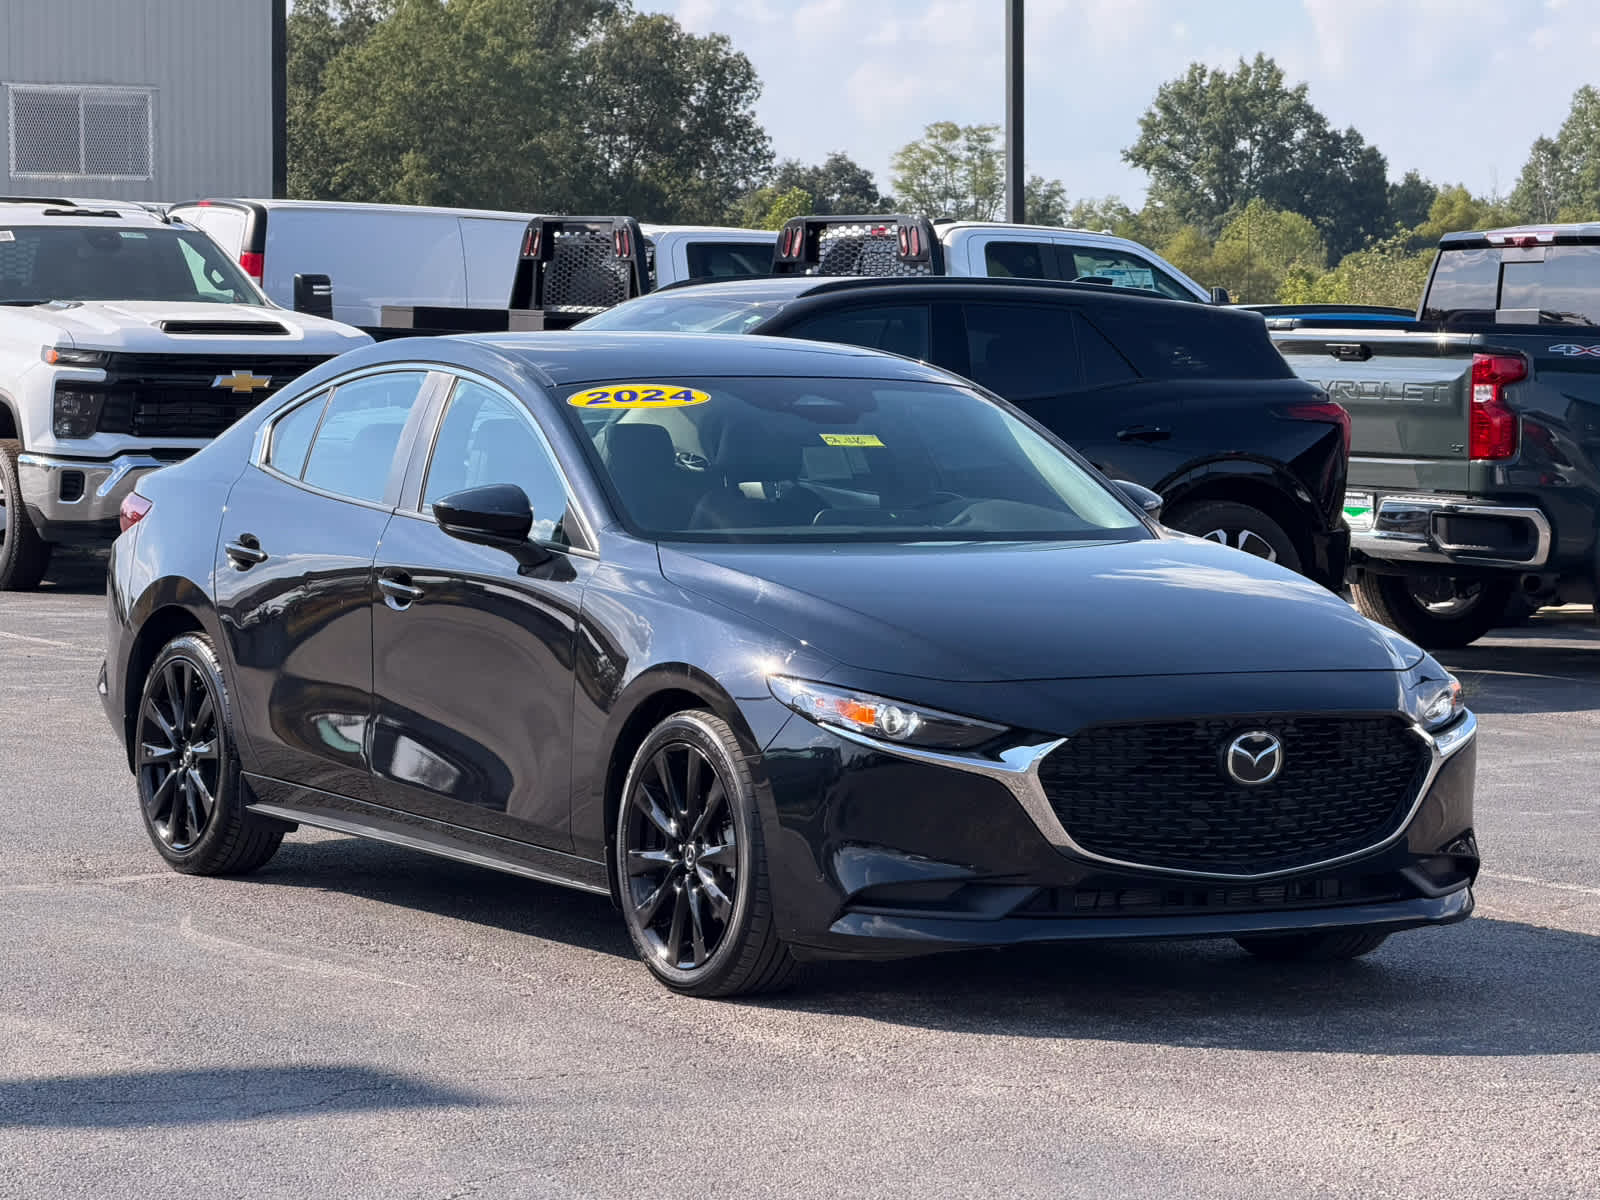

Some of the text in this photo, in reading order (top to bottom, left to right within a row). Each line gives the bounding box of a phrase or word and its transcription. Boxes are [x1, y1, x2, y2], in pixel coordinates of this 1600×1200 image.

[1549, 344, 1600, 356] 4X
[586, 389, 696, 405] 2024
[1307, 379, 1449, 402] VROLET
